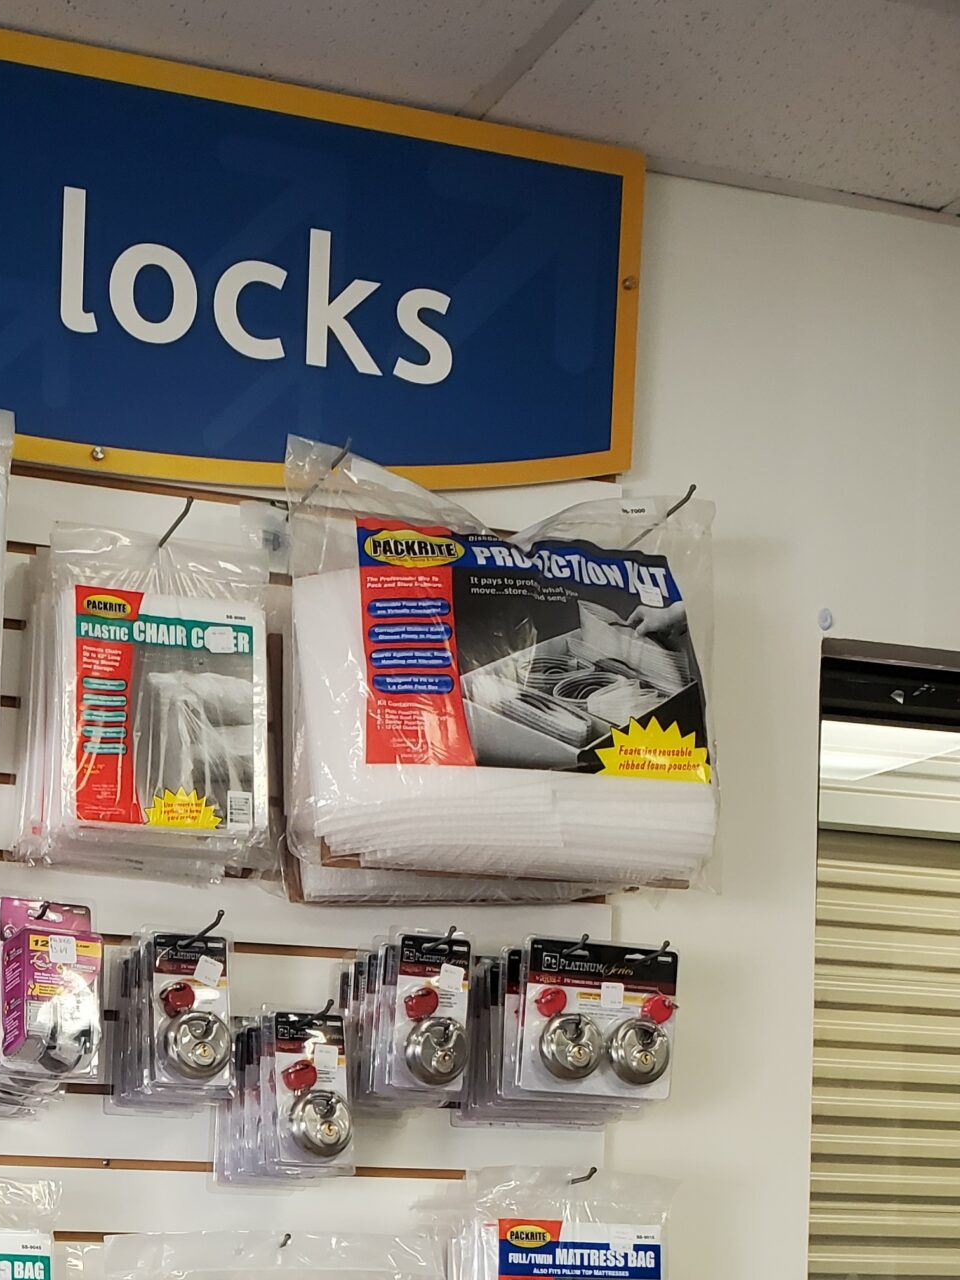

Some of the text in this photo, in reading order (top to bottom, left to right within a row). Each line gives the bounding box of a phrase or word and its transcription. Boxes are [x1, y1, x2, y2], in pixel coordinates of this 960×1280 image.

[60, 186, 453, 386] locks
[372, 536, 458, 558] PACKRITE
[471, 546, 668, 597] PROECTION KIT
[480, 578, 502, 587] pays
[86, 599, 127, 613] PACKRITE
[81, 621, 250, 653] PLASTIC CHAIR CER
[658, 748, 692, 757] reusable
[618, 760, 646, 770] ribbed
[647, 760, 666, 770] foam
[559, 958, 603, 973] PLATINUM
[510, 1231, 547, 1241] PACKRITE
[508, 1249, 655, 1268] FULL/TWIN MATTRESS BAG
[14, 1261, 45, 1280] BAG
